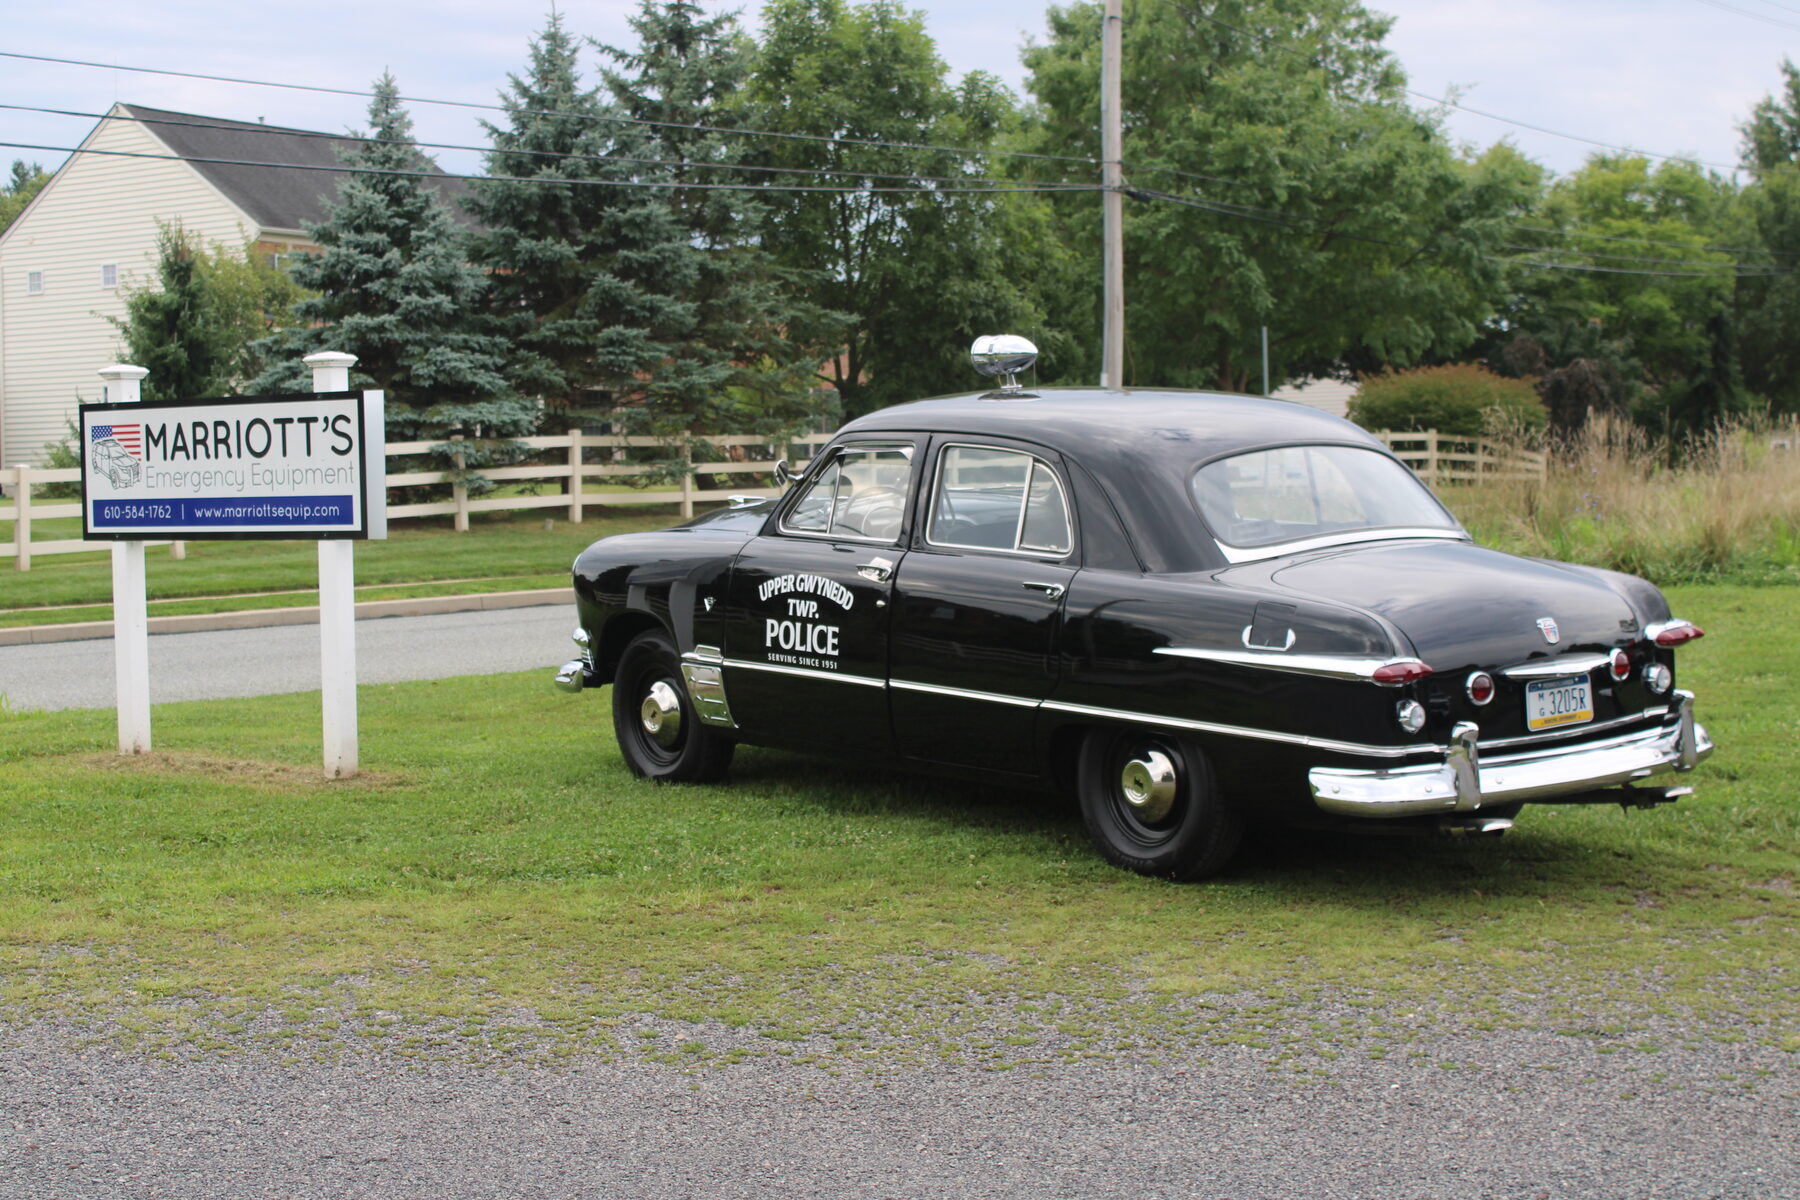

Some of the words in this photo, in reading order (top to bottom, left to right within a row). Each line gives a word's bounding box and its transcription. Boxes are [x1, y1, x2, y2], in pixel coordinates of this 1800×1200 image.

[145, 414, 354, 462] MARRIOTT'S
[146, 465, 245, 493] Emergency
[251, 462, 354, 491] Equipment
[104, 504, 172, 520] 610-584-1762
[194, 503, 340, 520] www.marriottsequip.com
[758, 574, 795, 602] UPPER
[796, 574, 854, 611] GWYNEDD
[787, 598, 820, 619] TWP.
[765, 618, 839, 656] POLICE
[767, 652, 797, 664] SERVING
[798, 657, 820, 667] SINCE
[821, 660, 838, 670] 1951
[1549, 688, 1586, 715] 3205R
